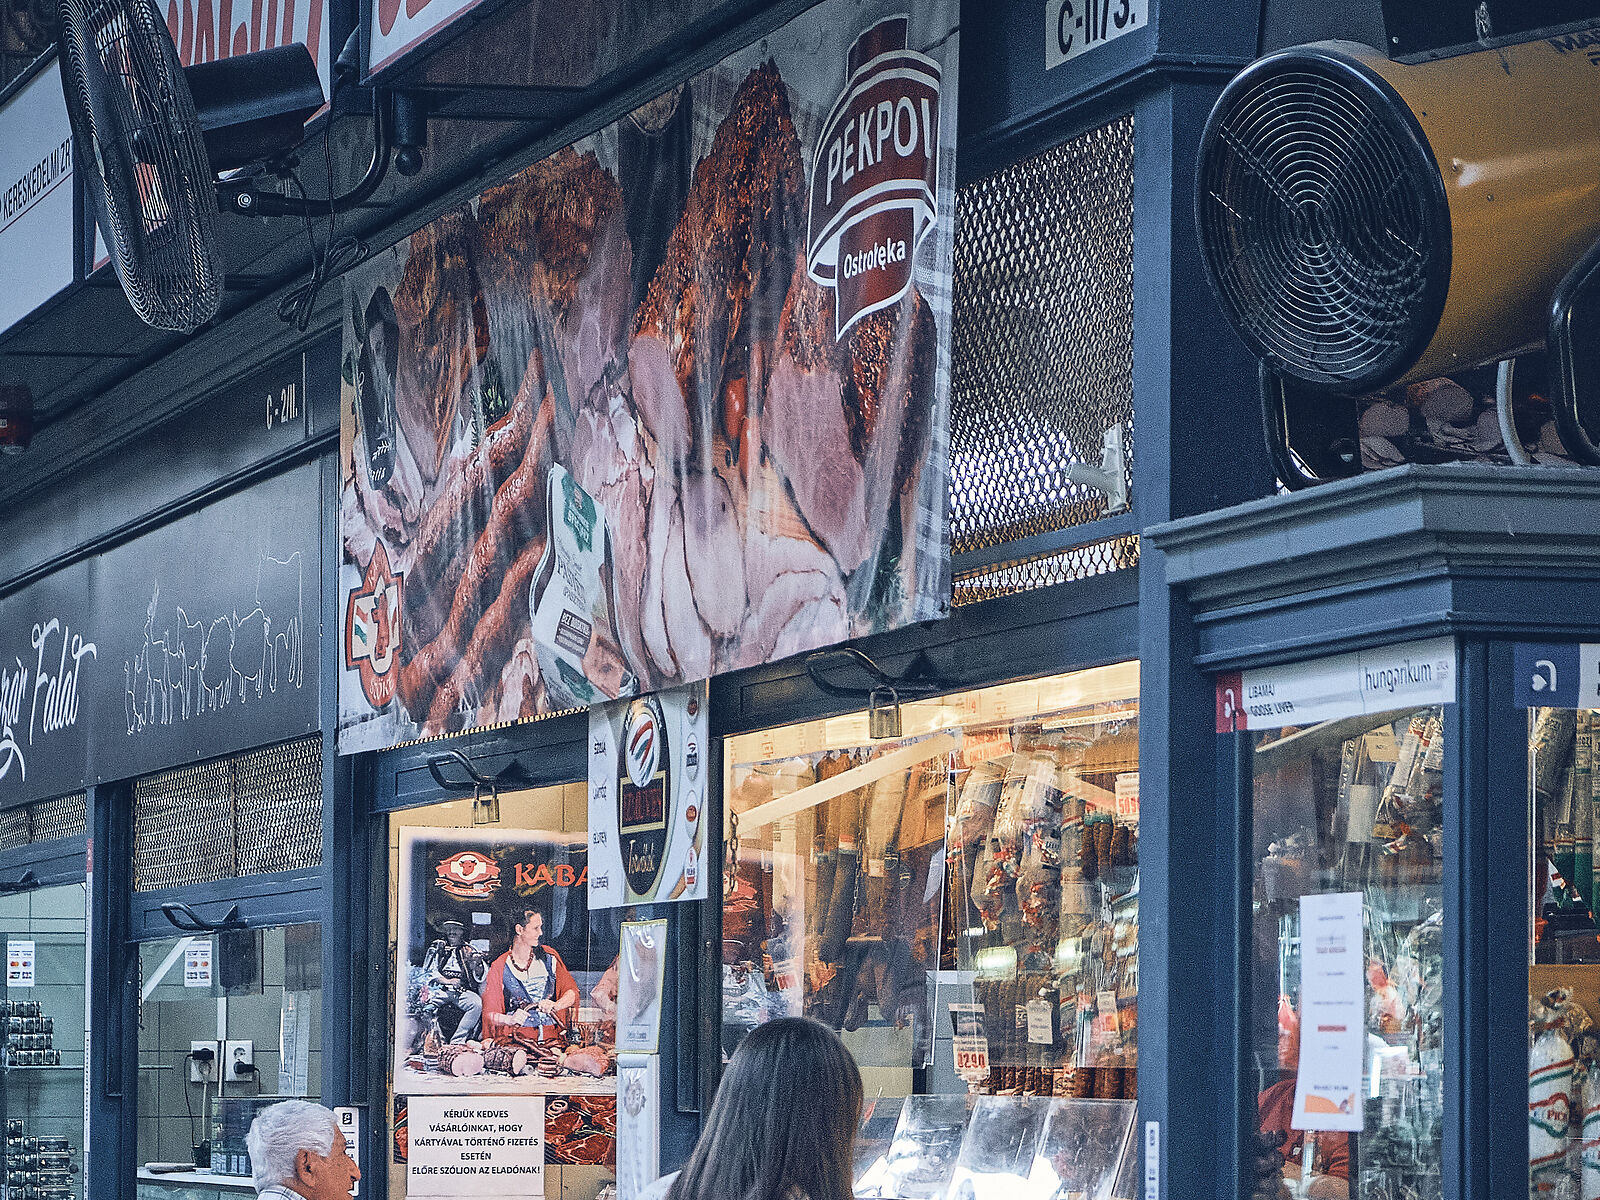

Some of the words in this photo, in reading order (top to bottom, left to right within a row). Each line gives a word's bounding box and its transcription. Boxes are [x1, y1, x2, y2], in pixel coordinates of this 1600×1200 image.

[3, 147, 59, 221] KERESKEDELMI
[61, 134, 73, 173] ZR
[843, 238, 906, 279] Ostrołęka
[1365, 659, 1432, 692] hungarikum
[1249, 703, 1274, 717] GOOSE
[1275, 701, 1294, 714] LIVER
[443, 1108, 475, 1119] KÉRJÜK
[476, 1109, 509, 1119] KEDVES
[429, 1123, 496, 1134] VÁSÁRLÓINKAT,
[498, 1123, 523, 1133] HOGY
[414, 1137, 463, 1147] KÁRTYÁVAL
[465, 1136, 506, 1147] TÖRTÉNŐ
[507, 1136, 539, 1147] FIZETÉS
[460, 1150, 492, 1161] ESETÉN
[412, 1165, 438, 1175] ELŐRE
[478, 1166, 490, 1175] AZ
[491, 1165, 540, 1175] ELADÓNAK!
